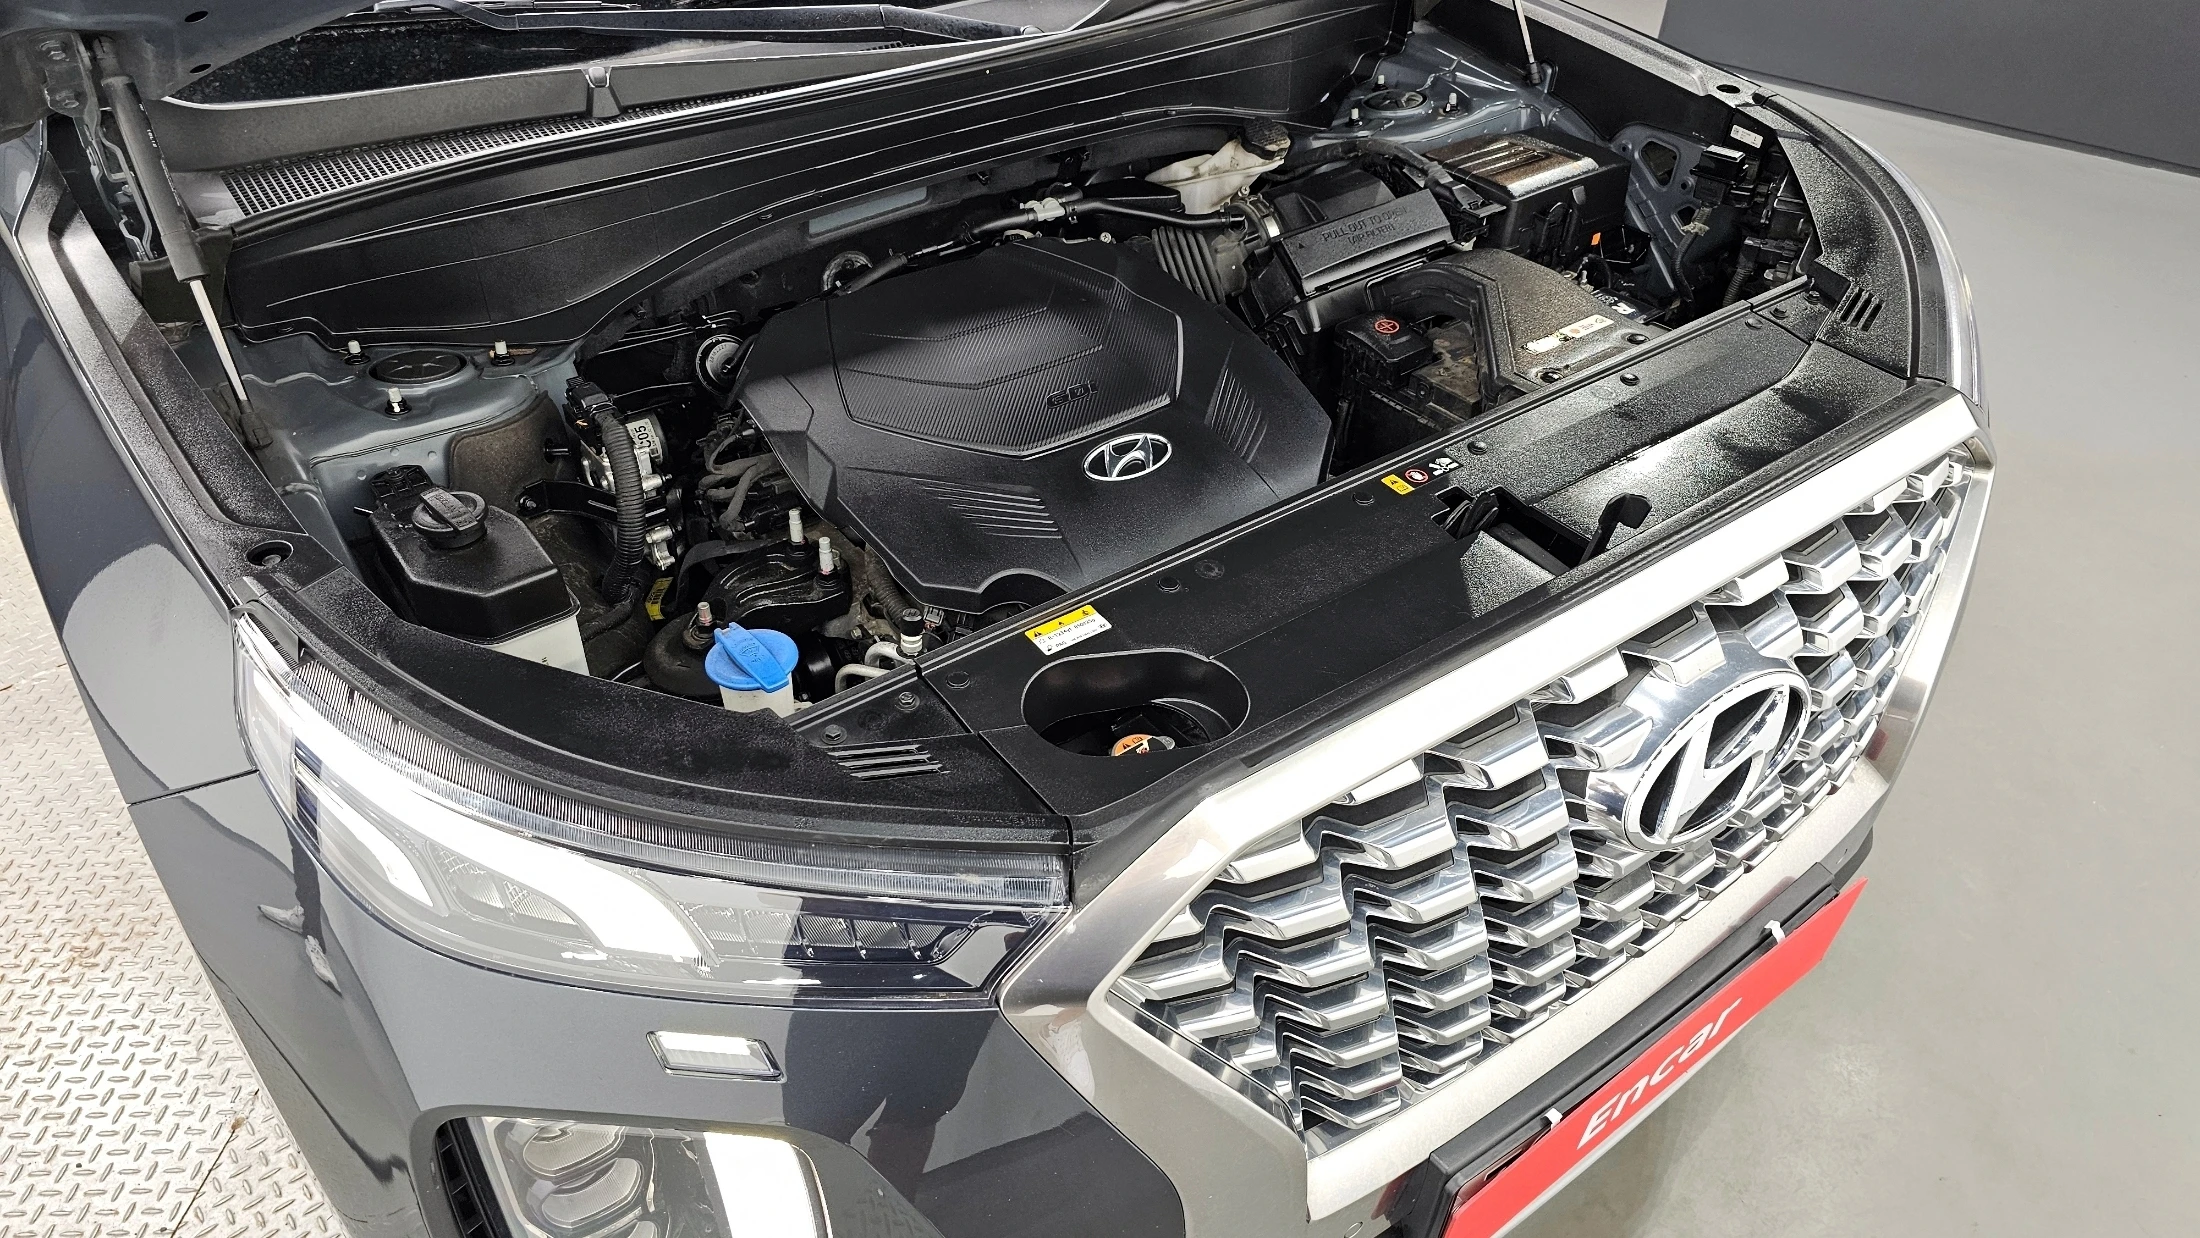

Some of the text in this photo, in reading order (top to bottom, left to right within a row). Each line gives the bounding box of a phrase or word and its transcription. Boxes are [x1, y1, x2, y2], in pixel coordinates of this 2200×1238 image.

[1322, 227, 1348, 242] PULL
[1347, 219, 1367, 233] OUT
[1370, 215, 1382, 226] TO
[1576, 997, 1743, 1150] Encar
